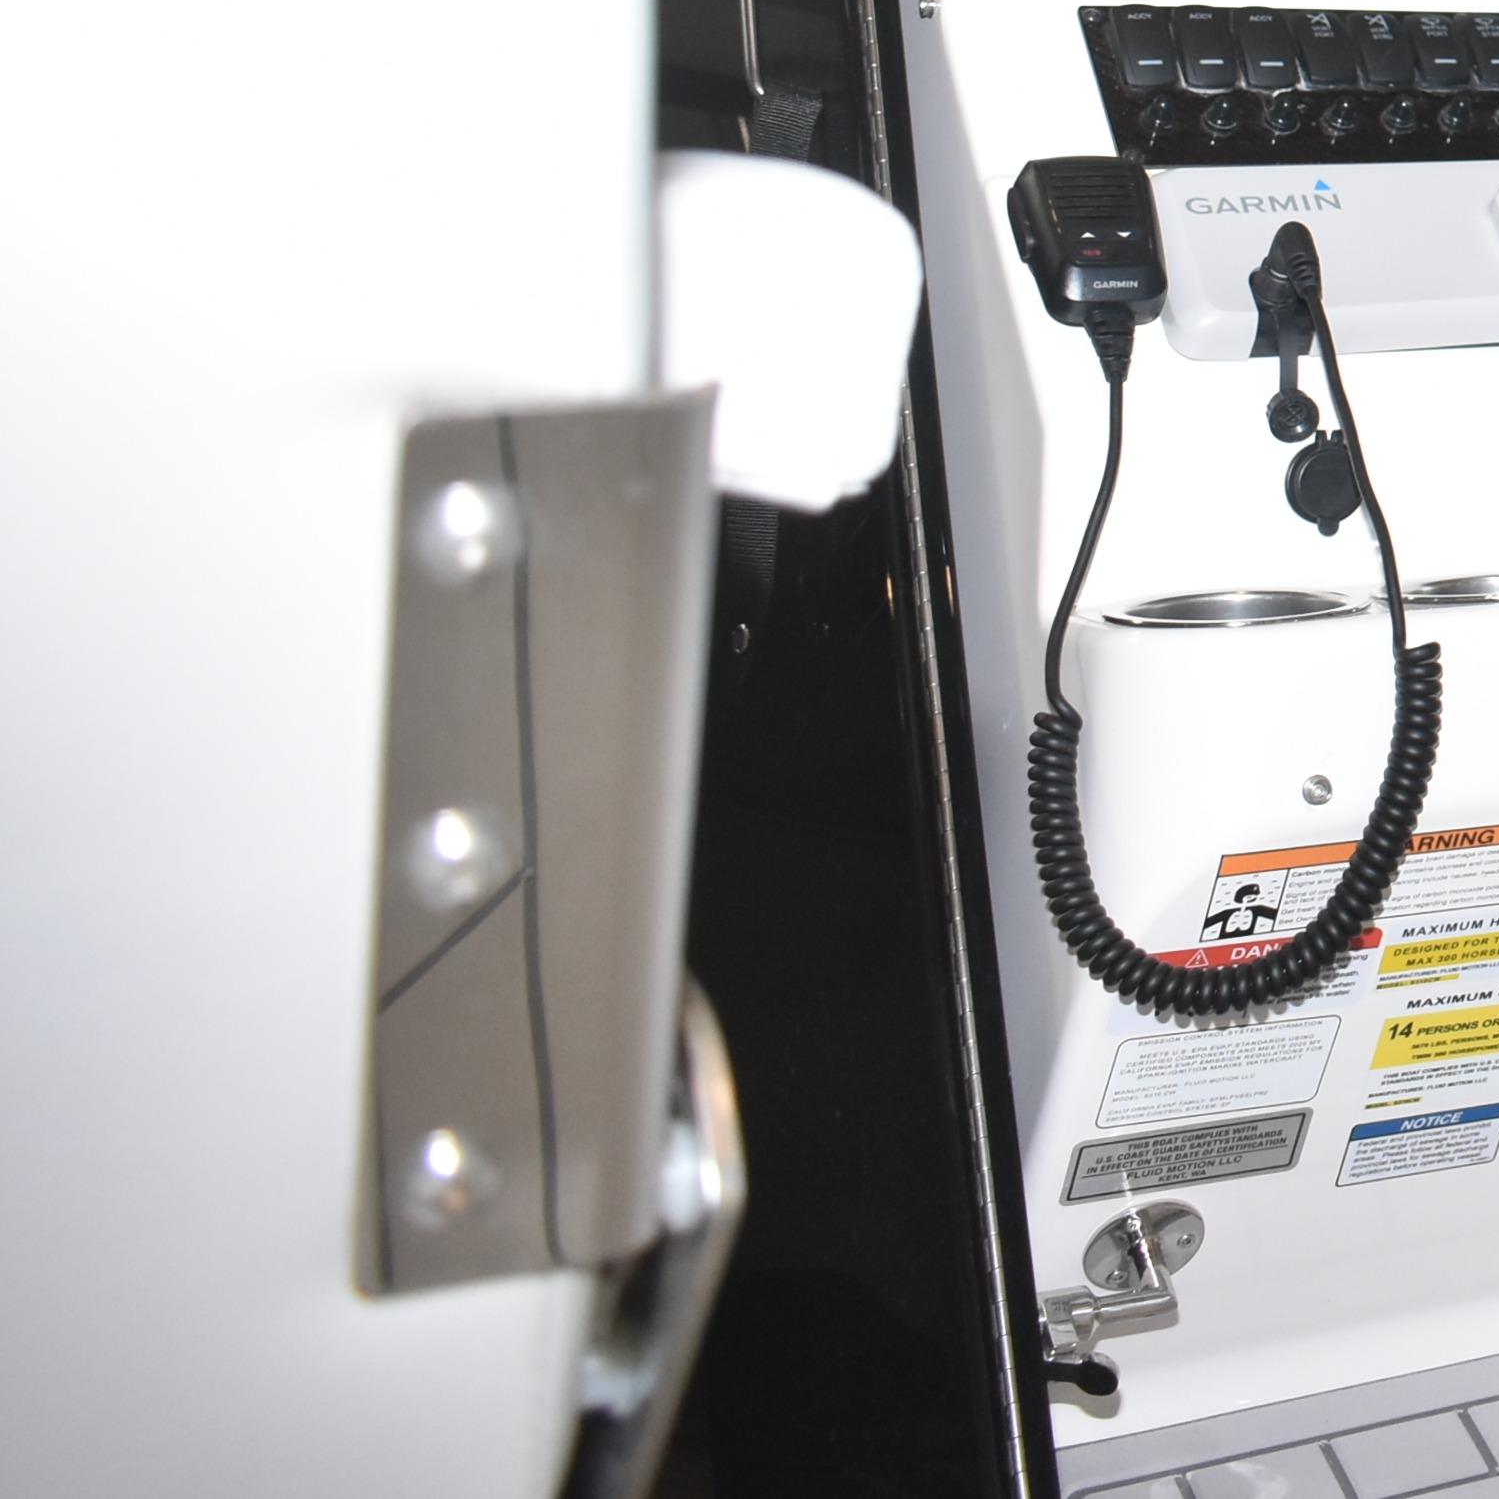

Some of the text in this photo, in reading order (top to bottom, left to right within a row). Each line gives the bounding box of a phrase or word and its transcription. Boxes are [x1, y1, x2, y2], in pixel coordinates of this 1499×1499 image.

[1185, 193, 1342, 215] GARMIN
[1093, 280, 1139, 289] GARMIN
[1404, 829, 1495, 852] ARNING
[1402, 920, 1484, 938] MAXIMUM
[1393, 941, 1460, 957] DESIGNED
[1463, 937, 1489, 947] FOR
[1406, 957, 1433, 967] MAX
[1438, 953, 1458, 964] 300
[1406, 989, 1492, 1009] MAXIMUM
[1138, 1019, 1323, 1047] EMISSION CONTROL SYSTEM INFORMATION
[1388, 1022, 1414, 1040] 14
[1416, 1020, 1479, 1036] PERSONS
[1401, 1112, 1463, 1131] NOTICE
[1127, 1125, 1258, 1152] THIS BOAT COMPLIES WITH
[1087, 1136, 1287, 1175] IN EFFECT ON THE DATE OF CERTIFICATION
[1095, 1155, 1115, 1165] U.S.
[1117, 1149, 1150, 1161] COAST
[1152, 1144, 1188, 1156] GUARD
[1126, 1154, 1243, 1180] FLUID MOTION LLC
[1191, 1169, 1207, 1178] WA
